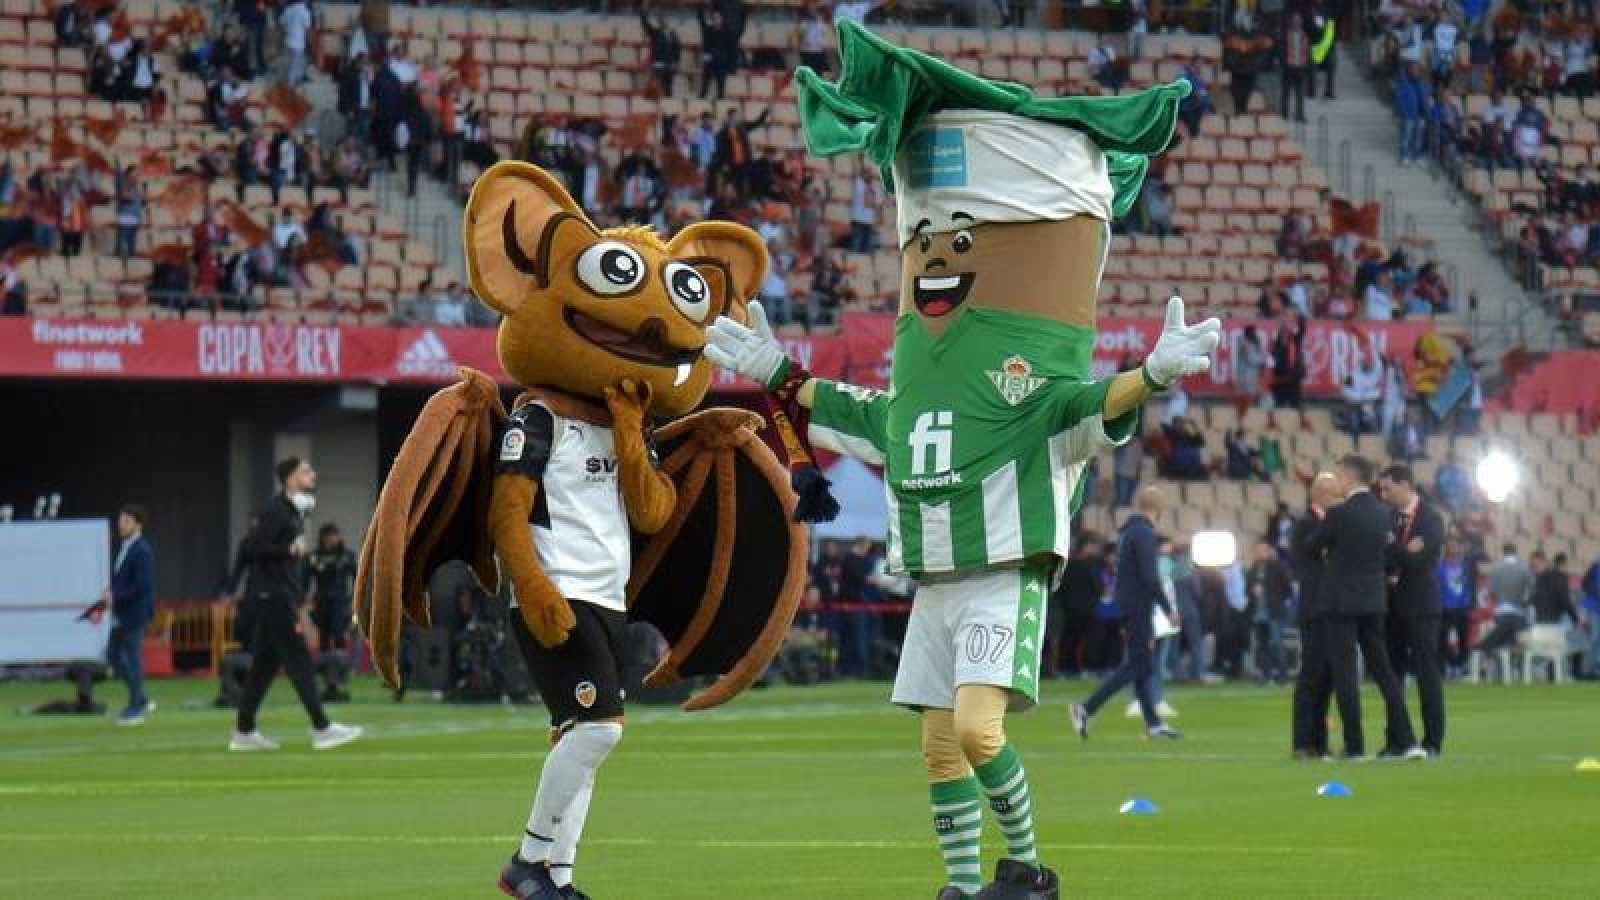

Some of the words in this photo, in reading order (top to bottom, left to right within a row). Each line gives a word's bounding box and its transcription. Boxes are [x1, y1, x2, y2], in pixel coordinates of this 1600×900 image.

[198, 325, 264, 374] COPA
[295, 326, 341, 374] REY
[908, 411, 953, 474] fi
[902, 470, 962, 489] network
[965, 623, 1013, 665] 07
